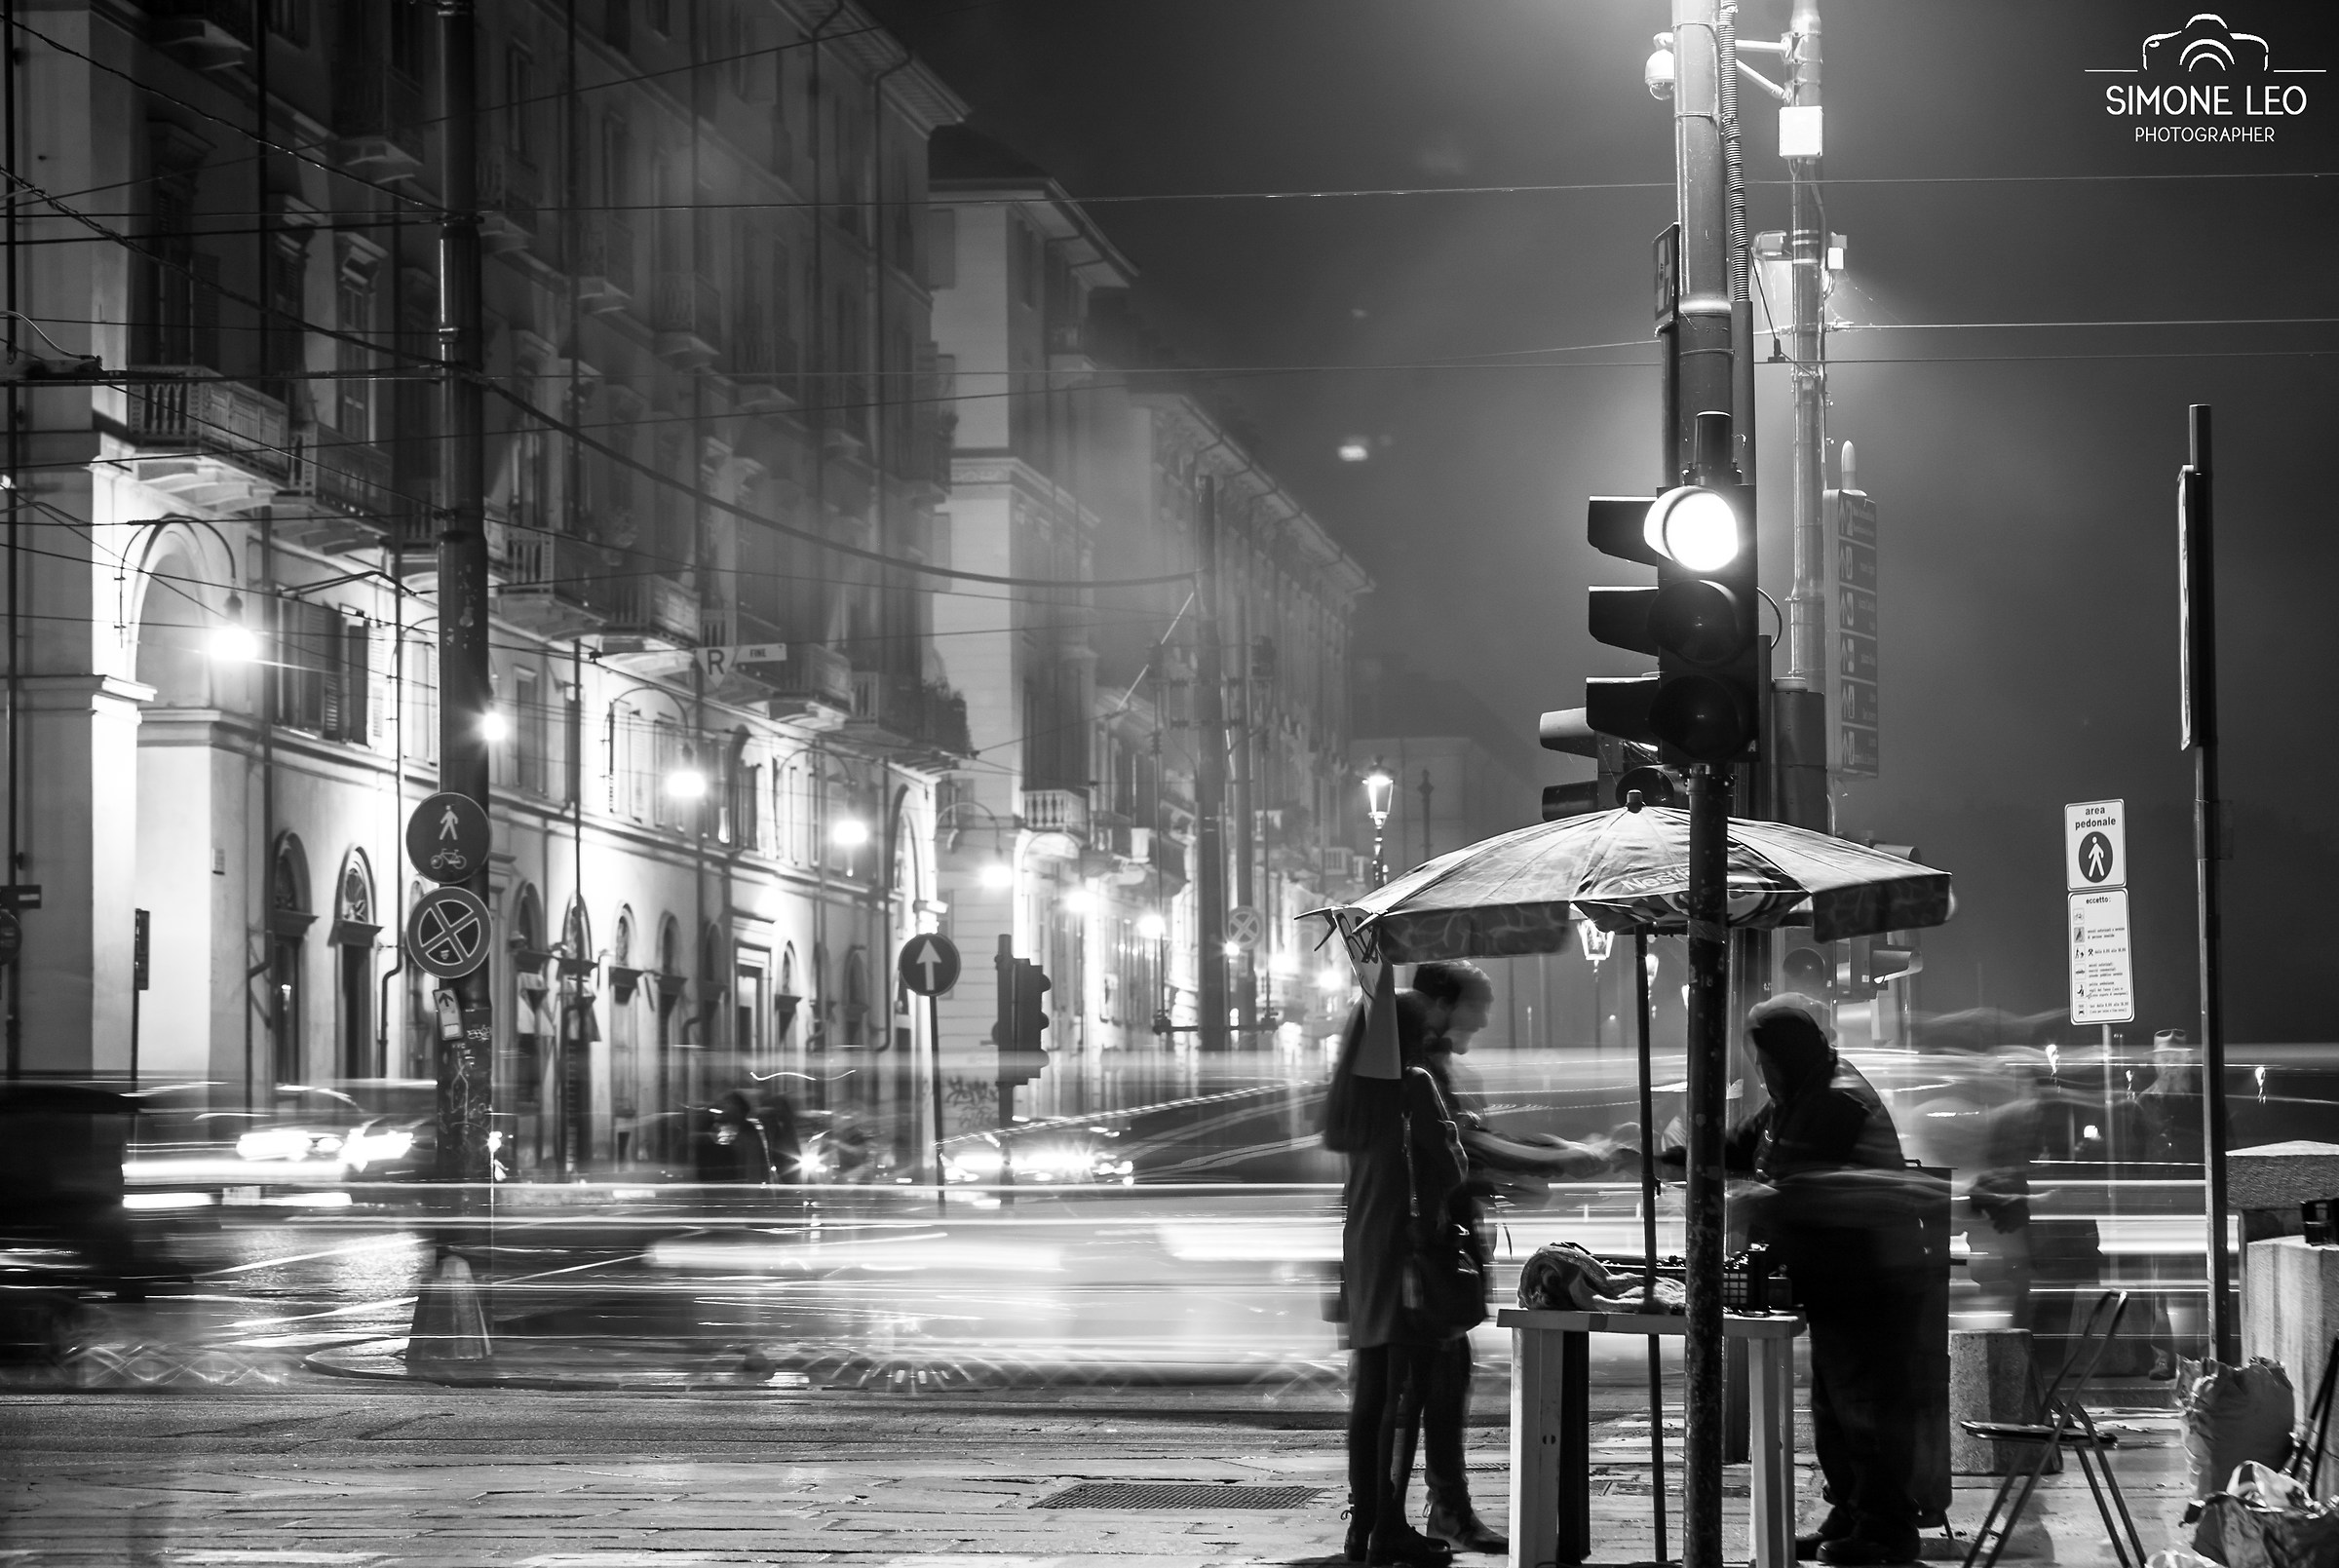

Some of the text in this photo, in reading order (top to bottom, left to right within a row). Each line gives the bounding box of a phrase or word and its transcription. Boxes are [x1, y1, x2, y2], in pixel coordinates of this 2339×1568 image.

[748, 648, 767, 658] FINE
[707, 649, 726, 675] R
[2085, 807, 2106, 816] area
[2075, 817, 2117, 830] pedonale
[1620, 867, 1690, 891] Nestl
